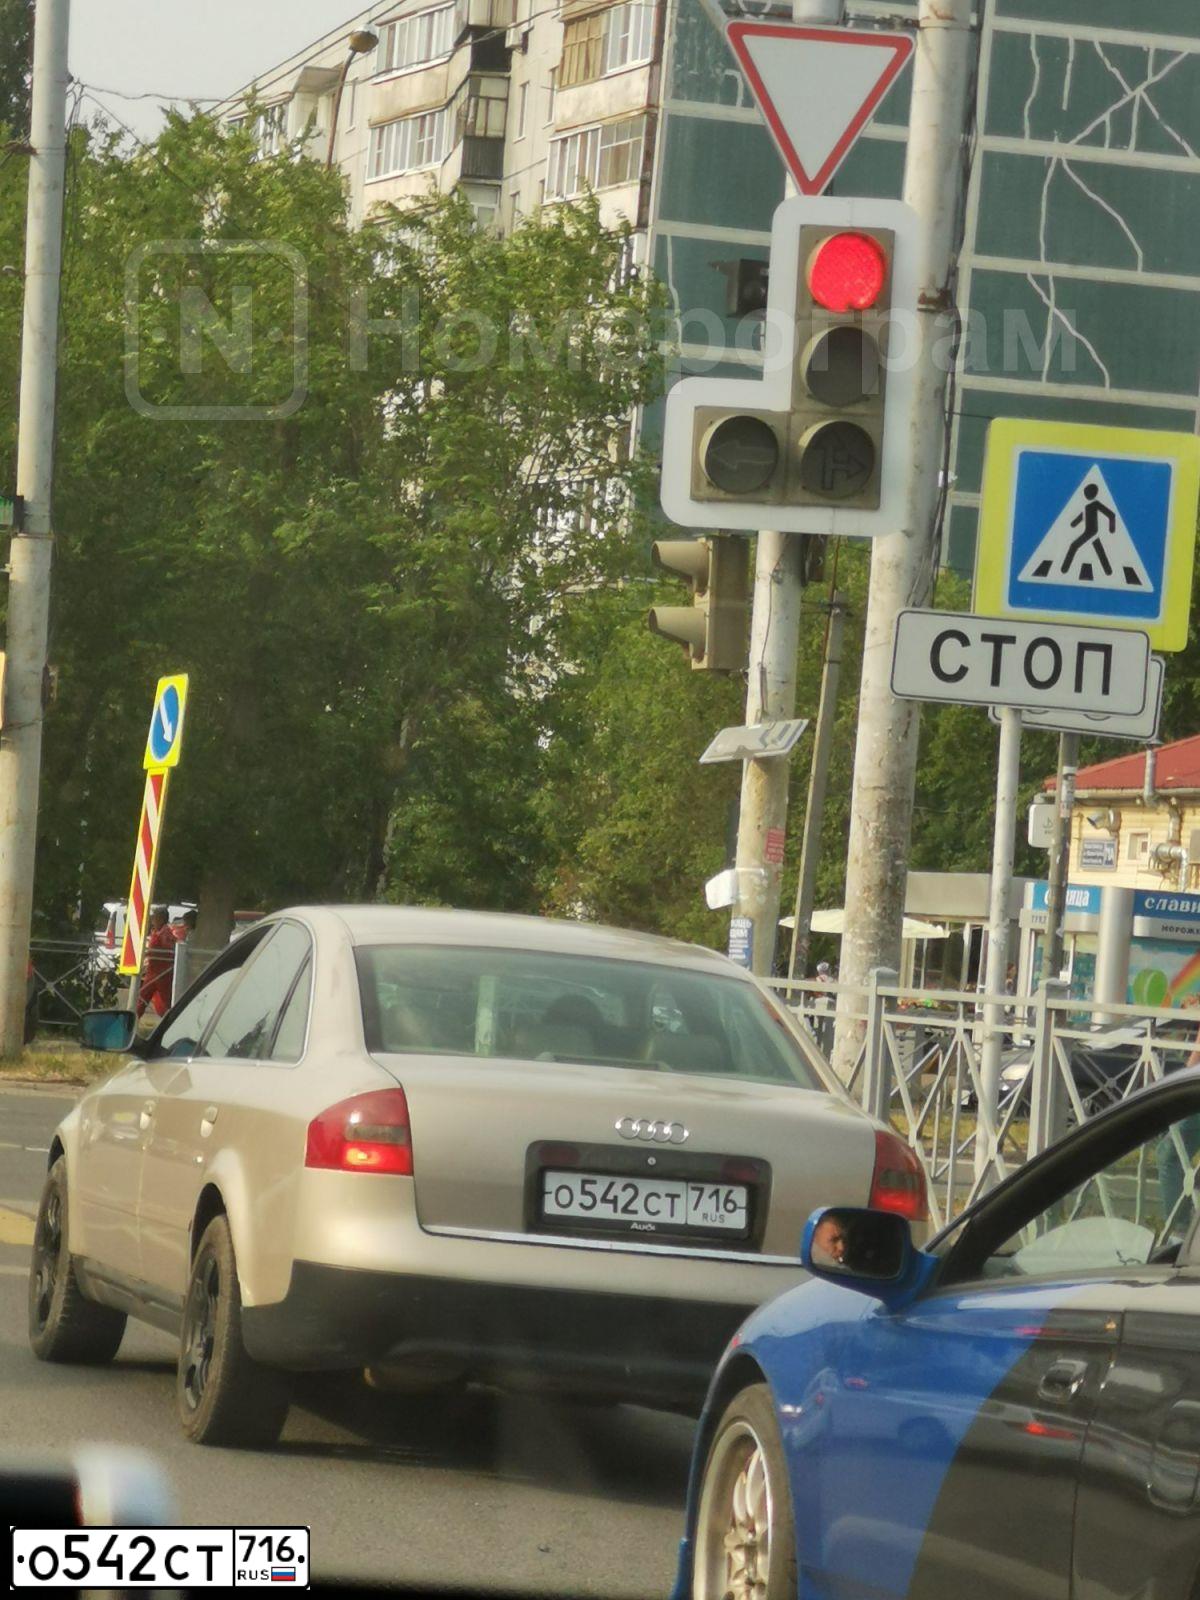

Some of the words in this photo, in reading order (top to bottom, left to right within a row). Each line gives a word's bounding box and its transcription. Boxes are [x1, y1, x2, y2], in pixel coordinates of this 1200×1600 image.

[930, 629, 1113, 696] СТОП
[554, 1179, 681, 1218] О542СТ
[690, 1186, 738, 1213] 716
[630, 1222, 656, 1231] Audi
[702, 1212, 726, 1224] RUS
